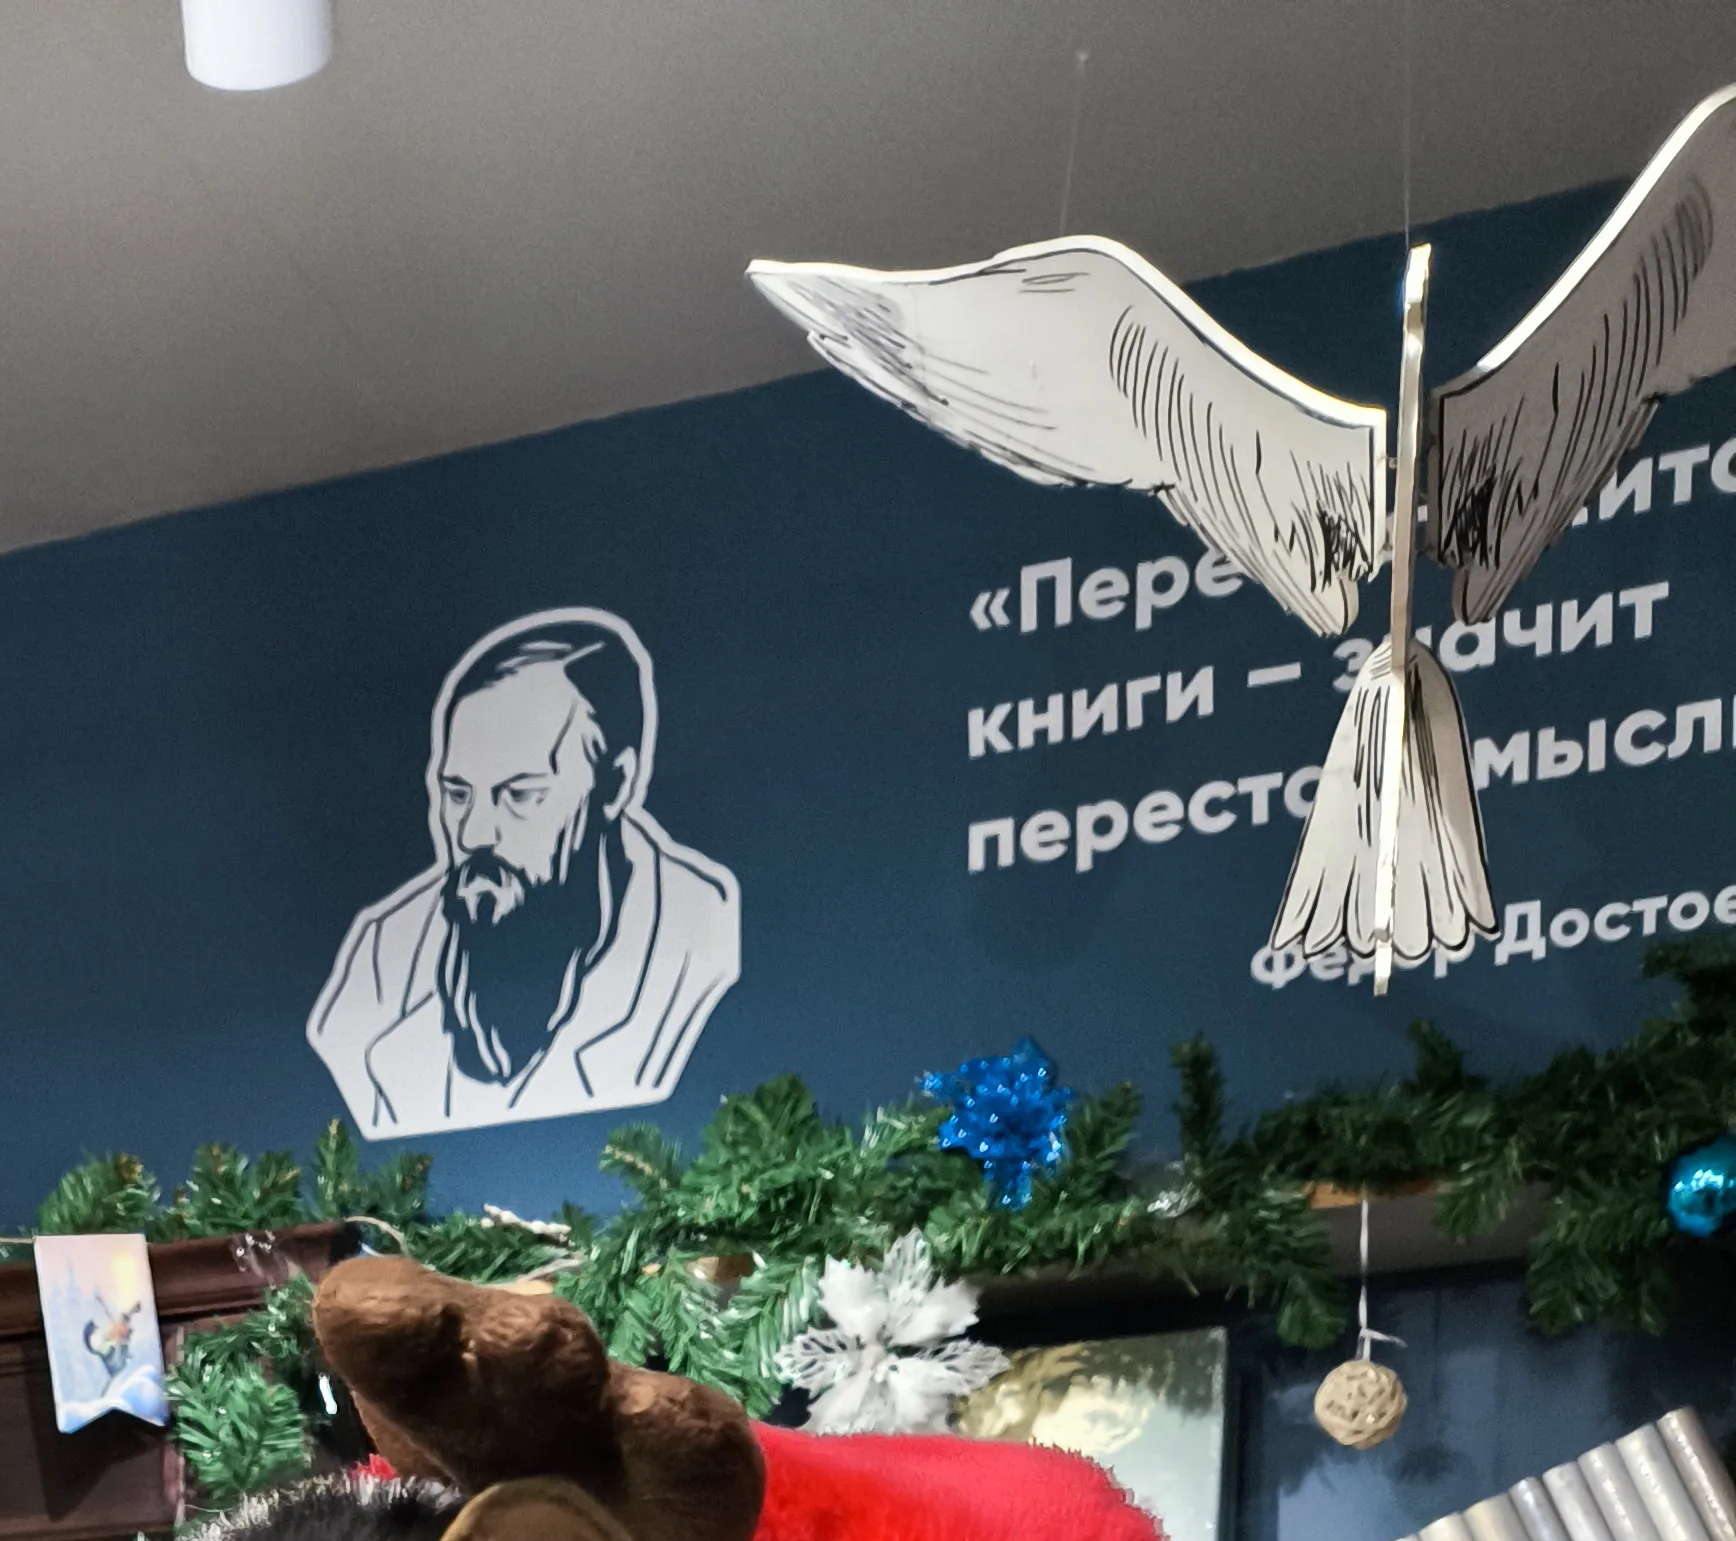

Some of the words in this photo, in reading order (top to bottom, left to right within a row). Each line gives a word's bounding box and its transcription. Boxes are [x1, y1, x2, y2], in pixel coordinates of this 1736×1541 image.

[967, 664, 1215, 759] книги
[1322, 580, 1669, 692] зачит
[1473, 697, 1736, 791] мысл
